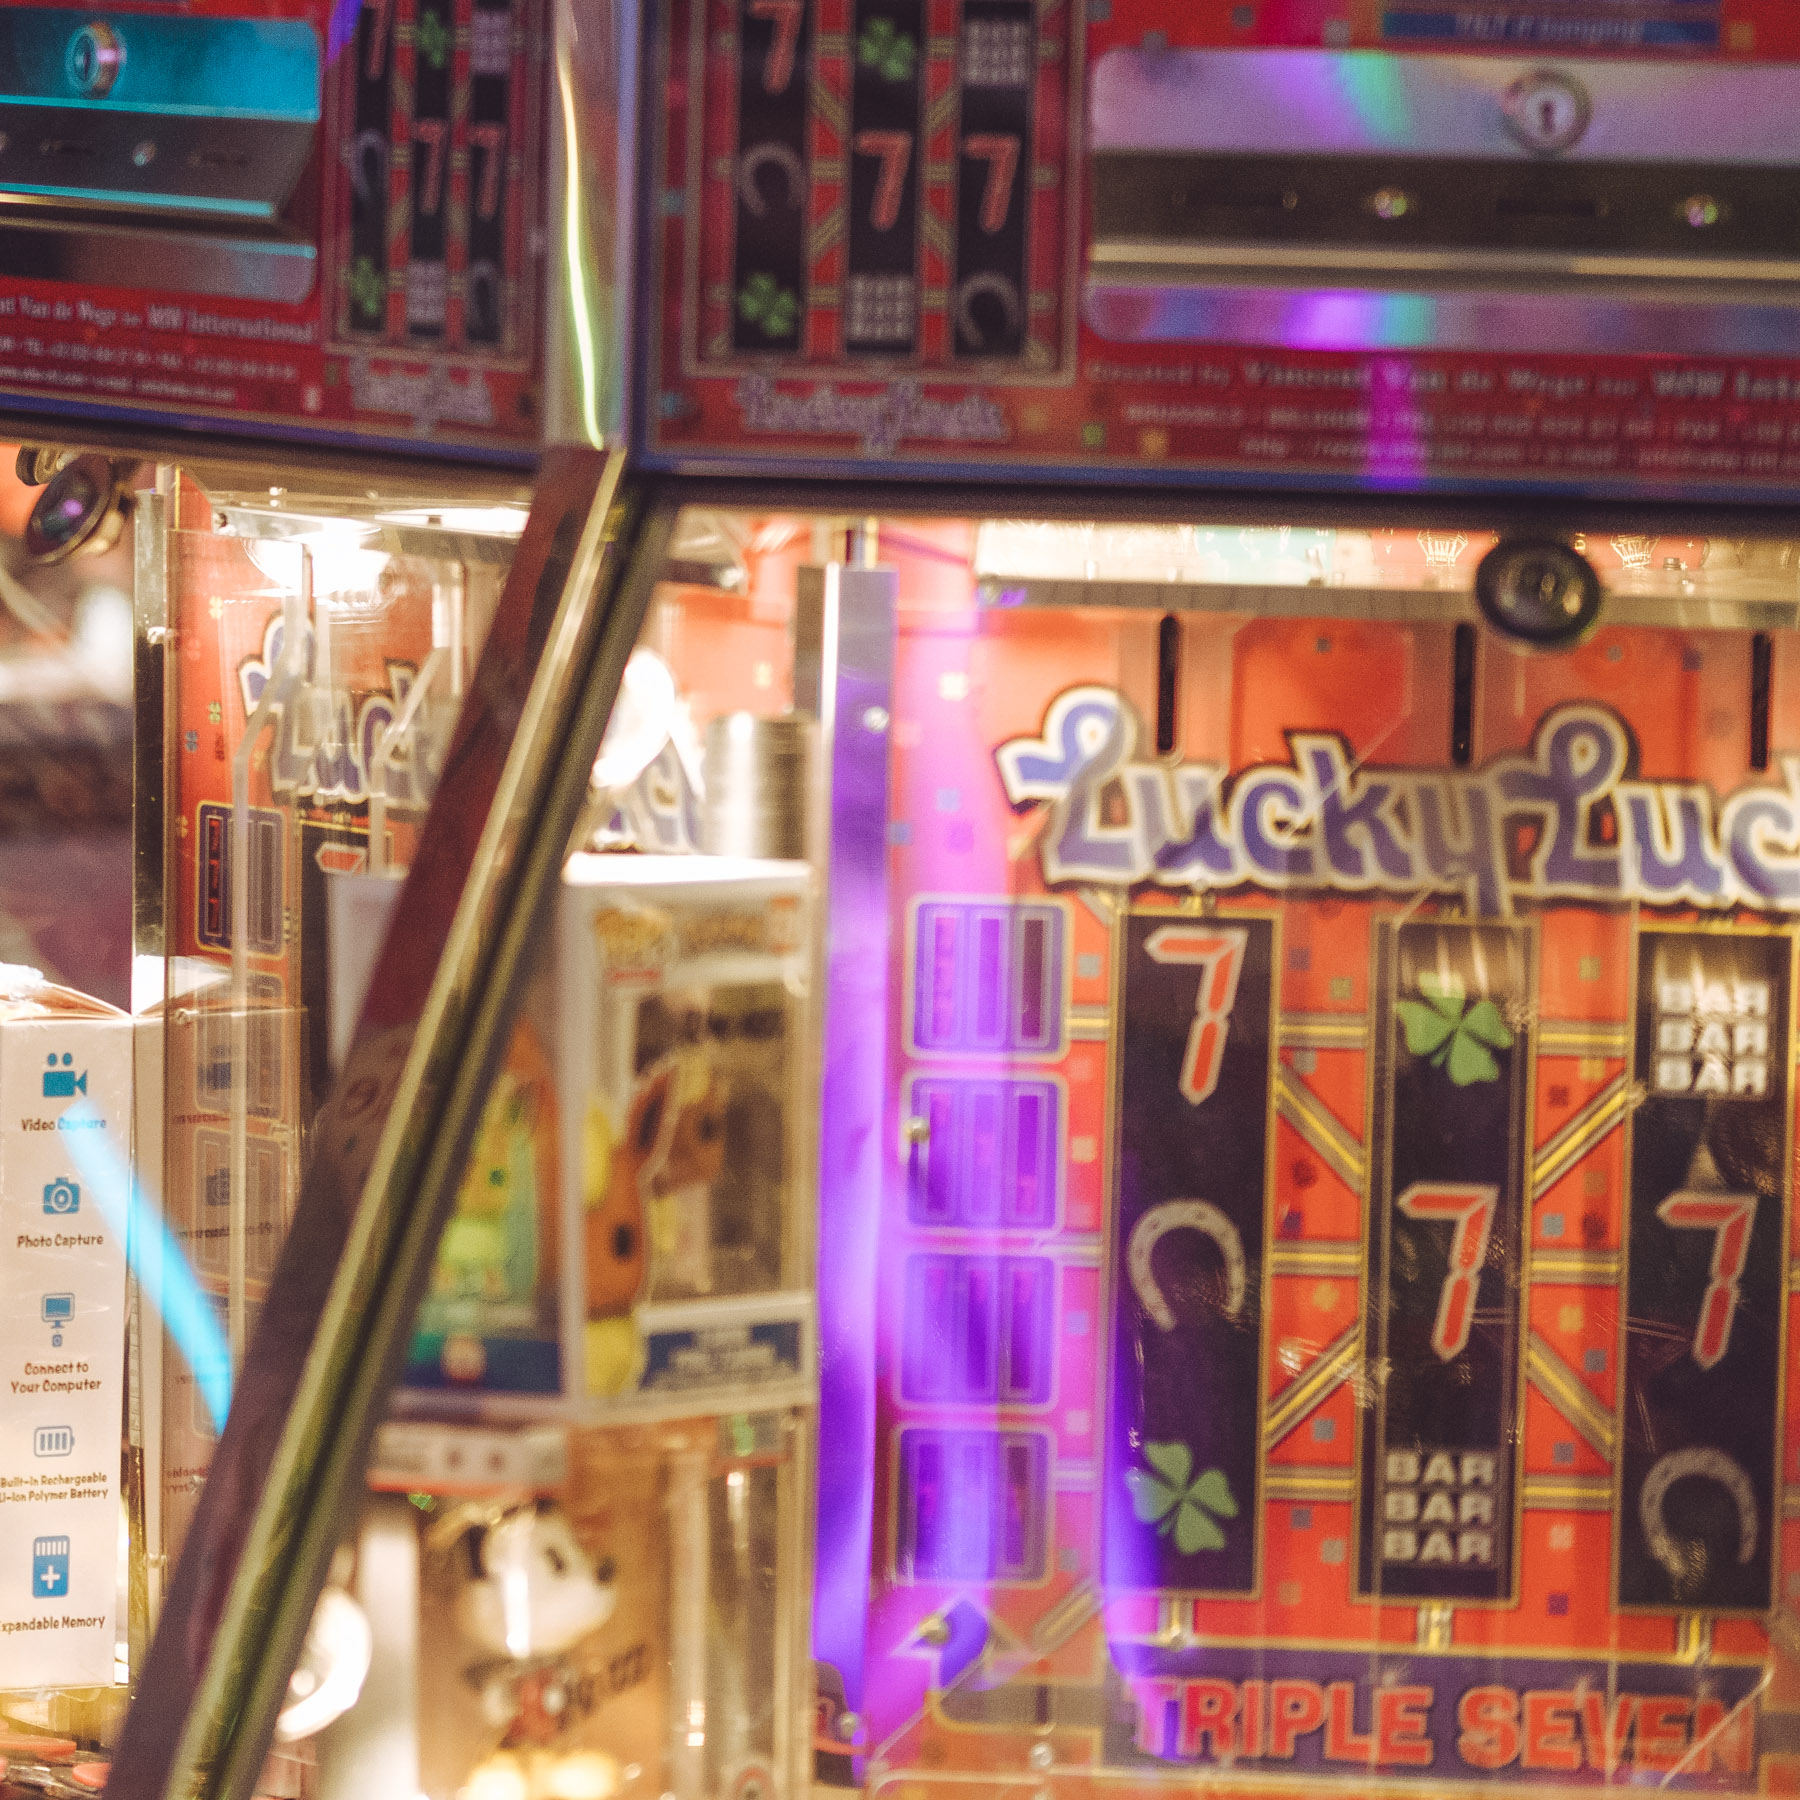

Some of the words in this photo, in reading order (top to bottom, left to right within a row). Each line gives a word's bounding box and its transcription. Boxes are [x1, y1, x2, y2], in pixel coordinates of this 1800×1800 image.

[856, 130, 913, 231] 7
[964, 133, 1021, 234] 7
[995, 684, 1512, 920] Lucky
[1480, 700, 1800, 911] Luc
[1144, 926, 1247, 1106] 7
[1654, 1017, 1771, 1056] BAR
[1652, 1056, 1770, 1094] BAR
[20, 1117, 56, 1132] Video
[57, 1116, 107, 1134] Capture
[16, 1233, 53, 1249] Photo
[54, 1233, 104, 1249] Capture
[1396, 1182, 1500, 1362] 7
[1656, 1190, 1760, 1372] 7
[11, 1380, 40, 1395] Your
[42, 1379, 103, 1396] Computer
[24, 1361, 73, 1377] Connect
[76, 1360, 89, 1374] to
[40, 1471, 108, 1488] Rechargeable
[1385, 1449, 1496, 1487] BAR
[29, 1487, 69, 1503] Polymer
[70, 1486, 110, 1502] Battery
[1384, 1490, 1496, 1527] BAR
[1383, 1527, 1495, 1565] BAR
[61, 1614, 106, 1633] Memory
[1133, 1676, 1435, 1766] TRIPLE
[1456, 1685, 1758, 1776] SEVEN
